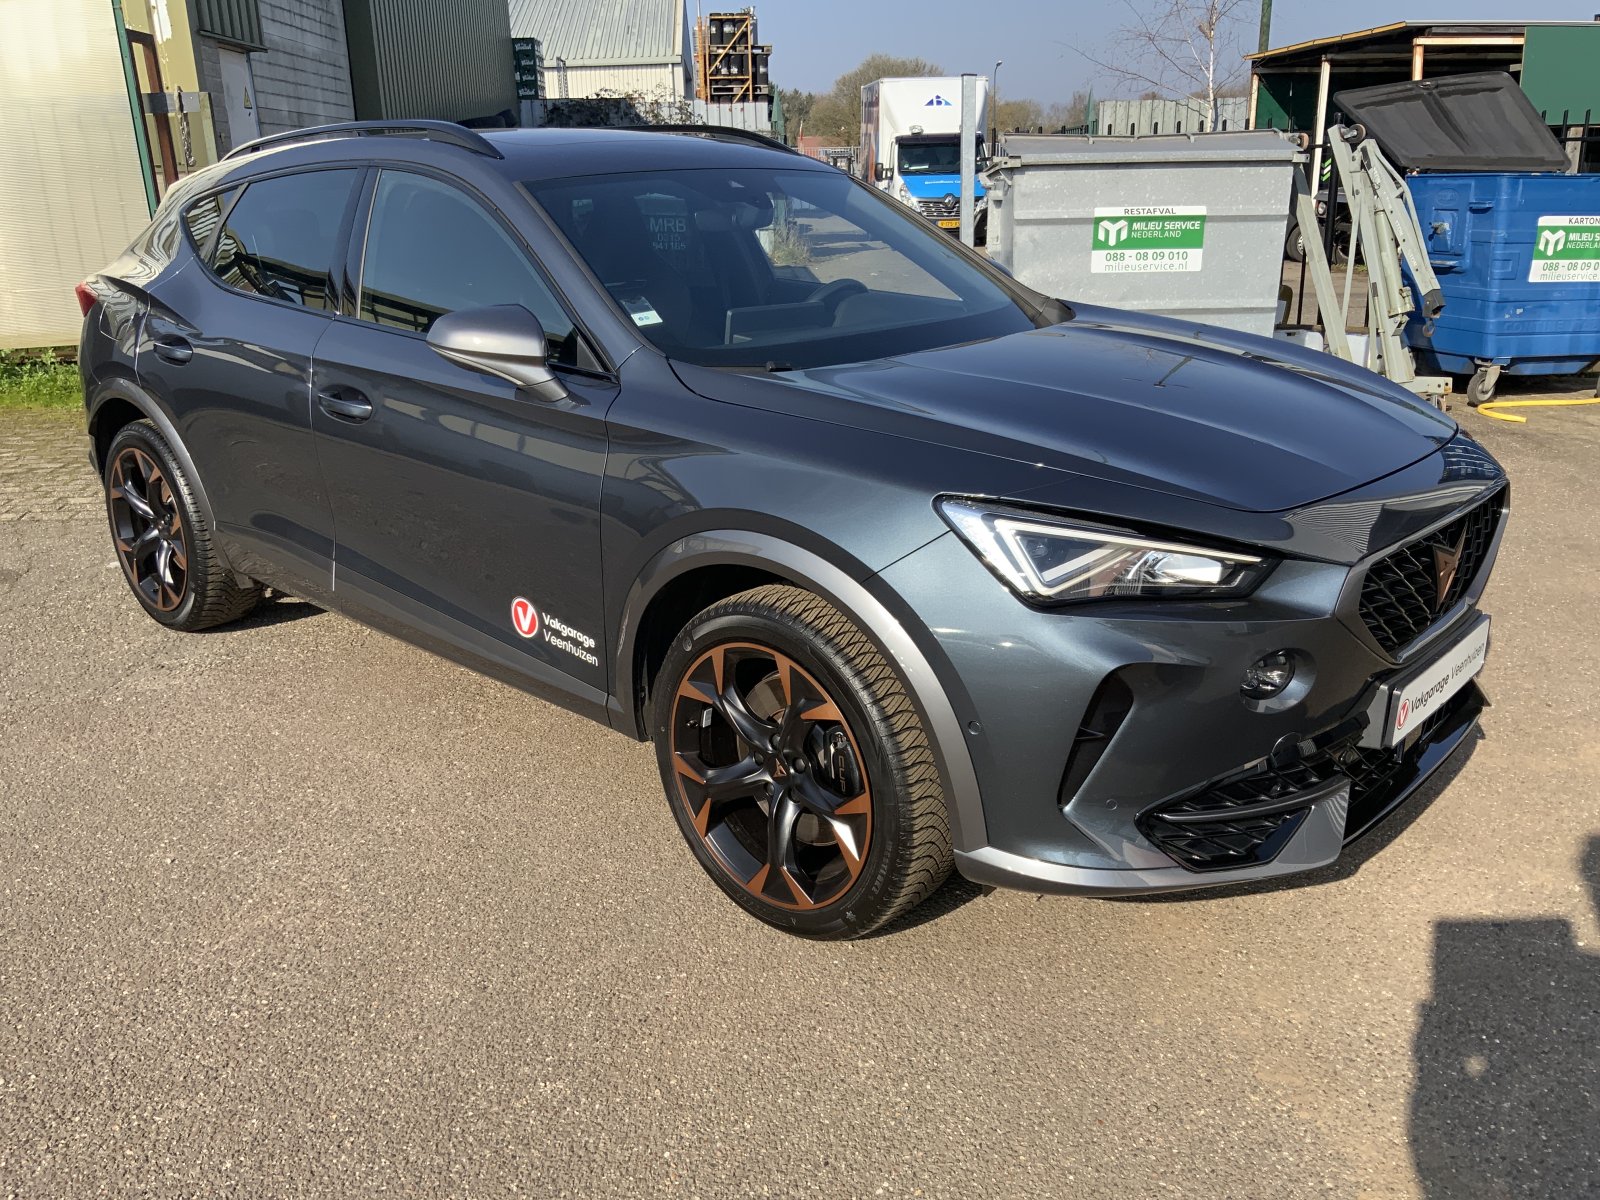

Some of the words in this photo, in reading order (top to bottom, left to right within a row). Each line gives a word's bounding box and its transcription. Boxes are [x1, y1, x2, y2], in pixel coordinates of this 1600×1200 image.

[650, 218, 686, 232] MRB
[1132, 222, 1162, 231] MILIEU
[1164, 221, 1201, 230] SERVICE
[1568, 232, 1593, 241] MILIEU
[1105, 253, 1125, 262] 088
[1135, 252, 1149, 261] 08
[1152, 252, 1165, 261] 09
[1168, 251, 1188, 260] 010
[1104, 261, 1188, 272] milieuservice.nl
[1542, 262, 1560, 272] 088
[1567, 262, 1579, 271] 08
[1580, 262, 1592, 271] 09
[542, 612, 596, 648] Vakgarage
[543, 628, 599, 667] Veenhuizen
[1411, 674, 1450, 713] Vakgarage
[1451, 642, 1485, 679] Veenhuizen
